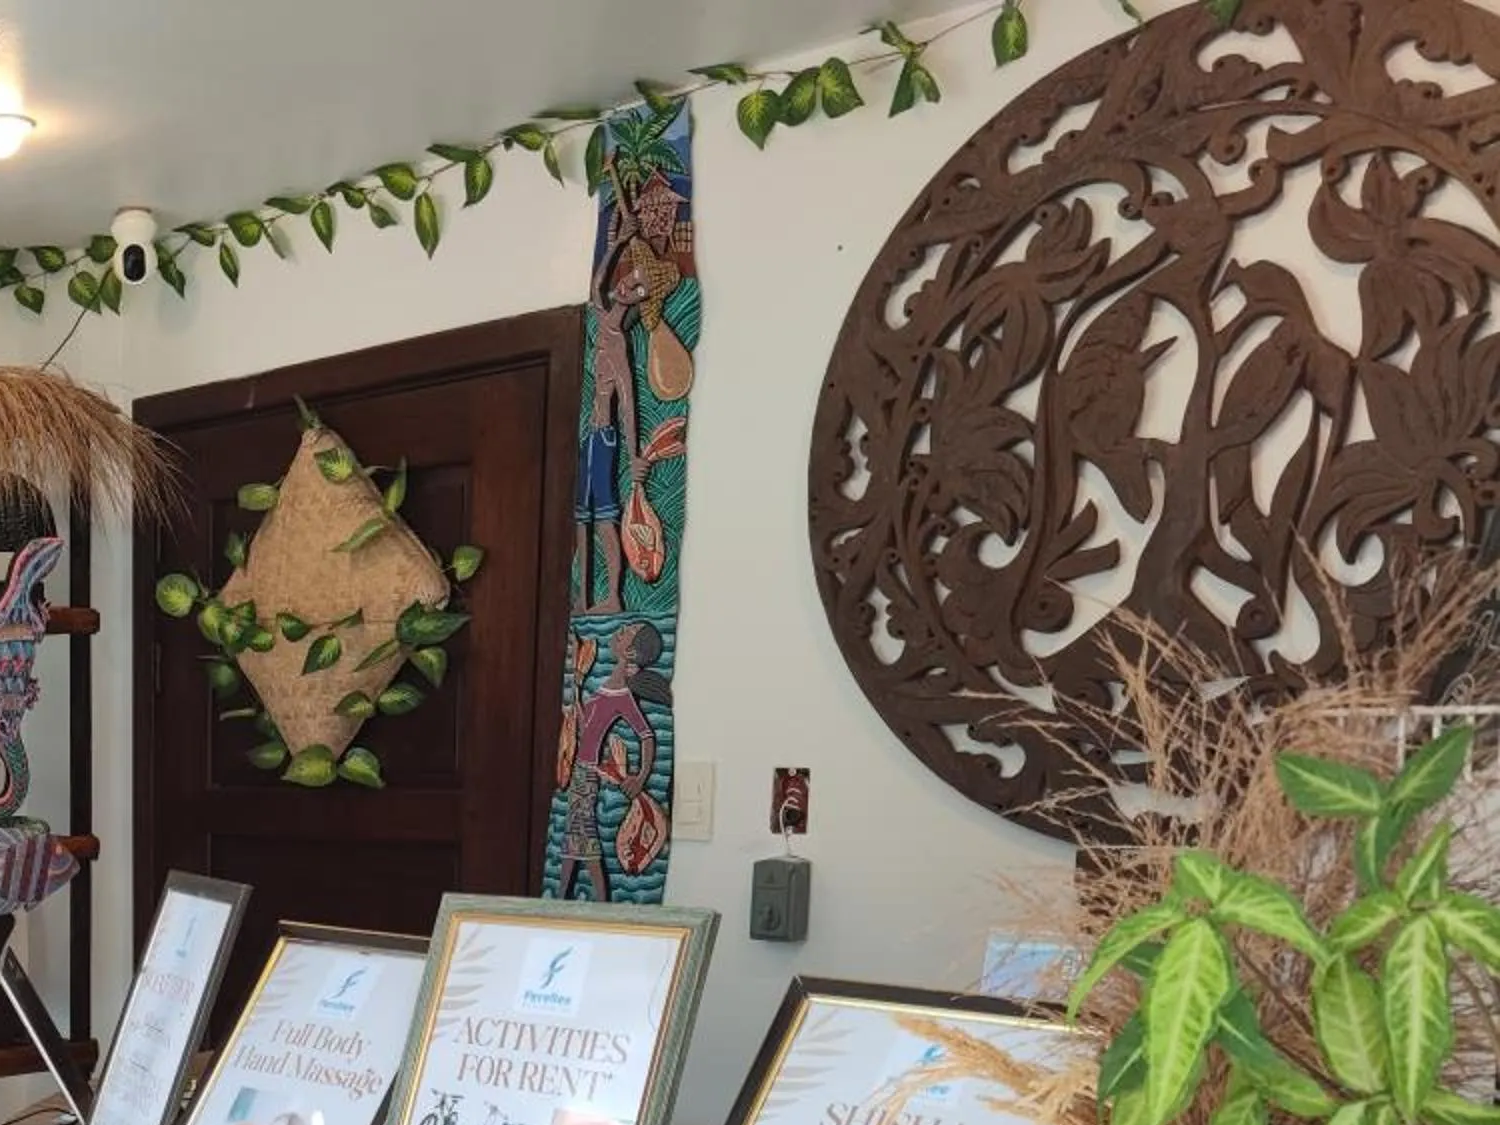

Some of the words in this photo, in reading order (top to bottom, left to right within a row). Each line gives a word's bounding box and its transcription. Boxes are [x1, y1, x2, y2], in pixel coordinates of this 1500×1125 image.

[271, 1019, 315, 1050] Full
[312, 1025, 366, 1061] Body
[453, 1016, 632, 1065] ACTIVITIES
[232, 1045, 292, 1076] Hand
[287, 1056, 383, 1100] Massage
[457, 1052, 513, 1089] FOR
[518, 1060, 609, 1102] RENT
